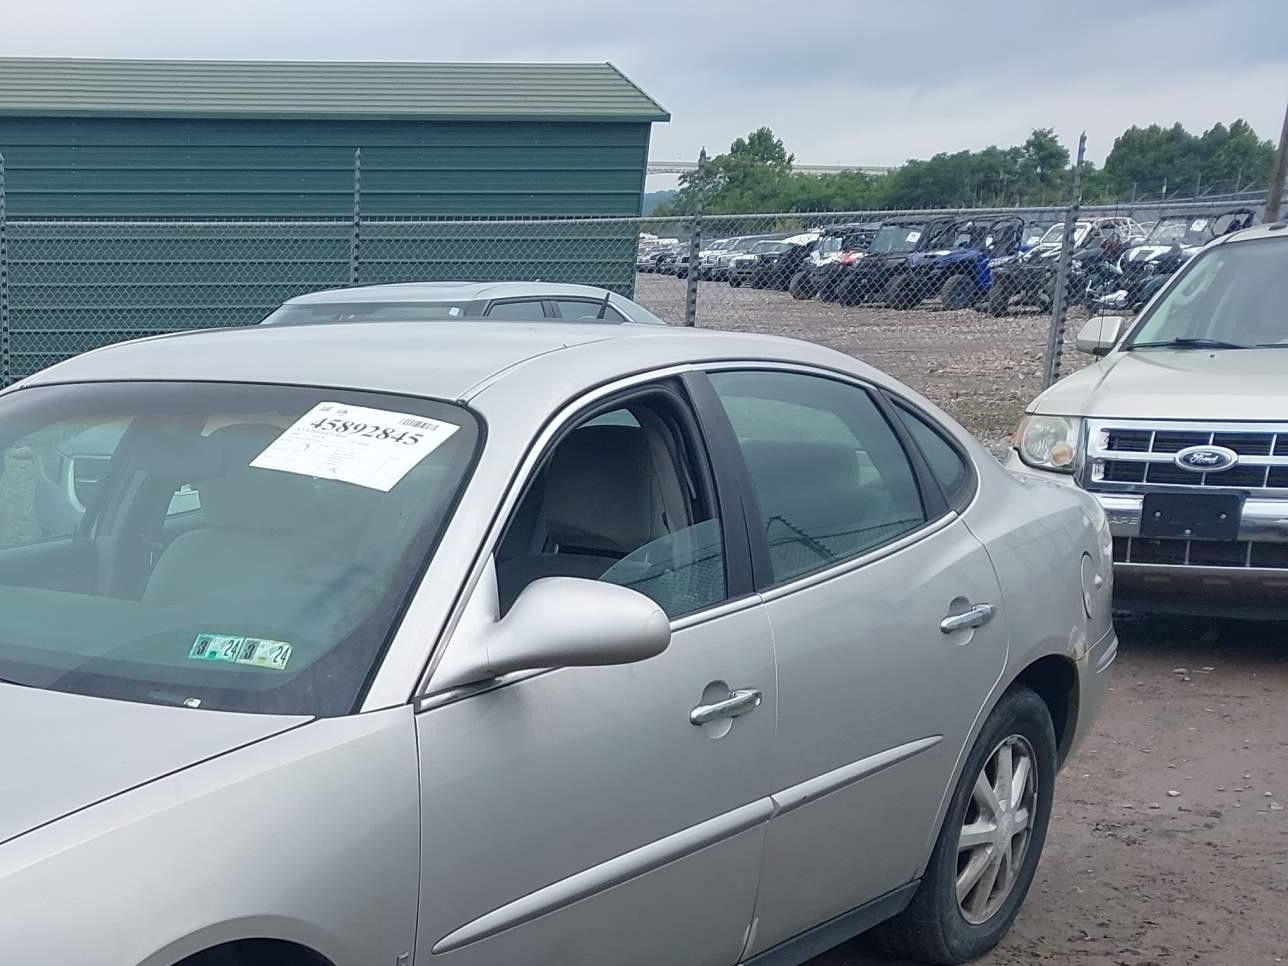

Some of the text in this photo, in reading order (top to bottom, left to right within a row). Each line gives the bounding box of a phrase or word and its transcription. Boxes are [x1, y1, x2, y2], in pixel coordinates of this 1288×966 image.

[310, 417, 425, 446] 45892845
[1188, 451, 1220, 465] Ford
[196, 639, 241, 658] 3 24
[244, 643, 290, 665] 3 24
